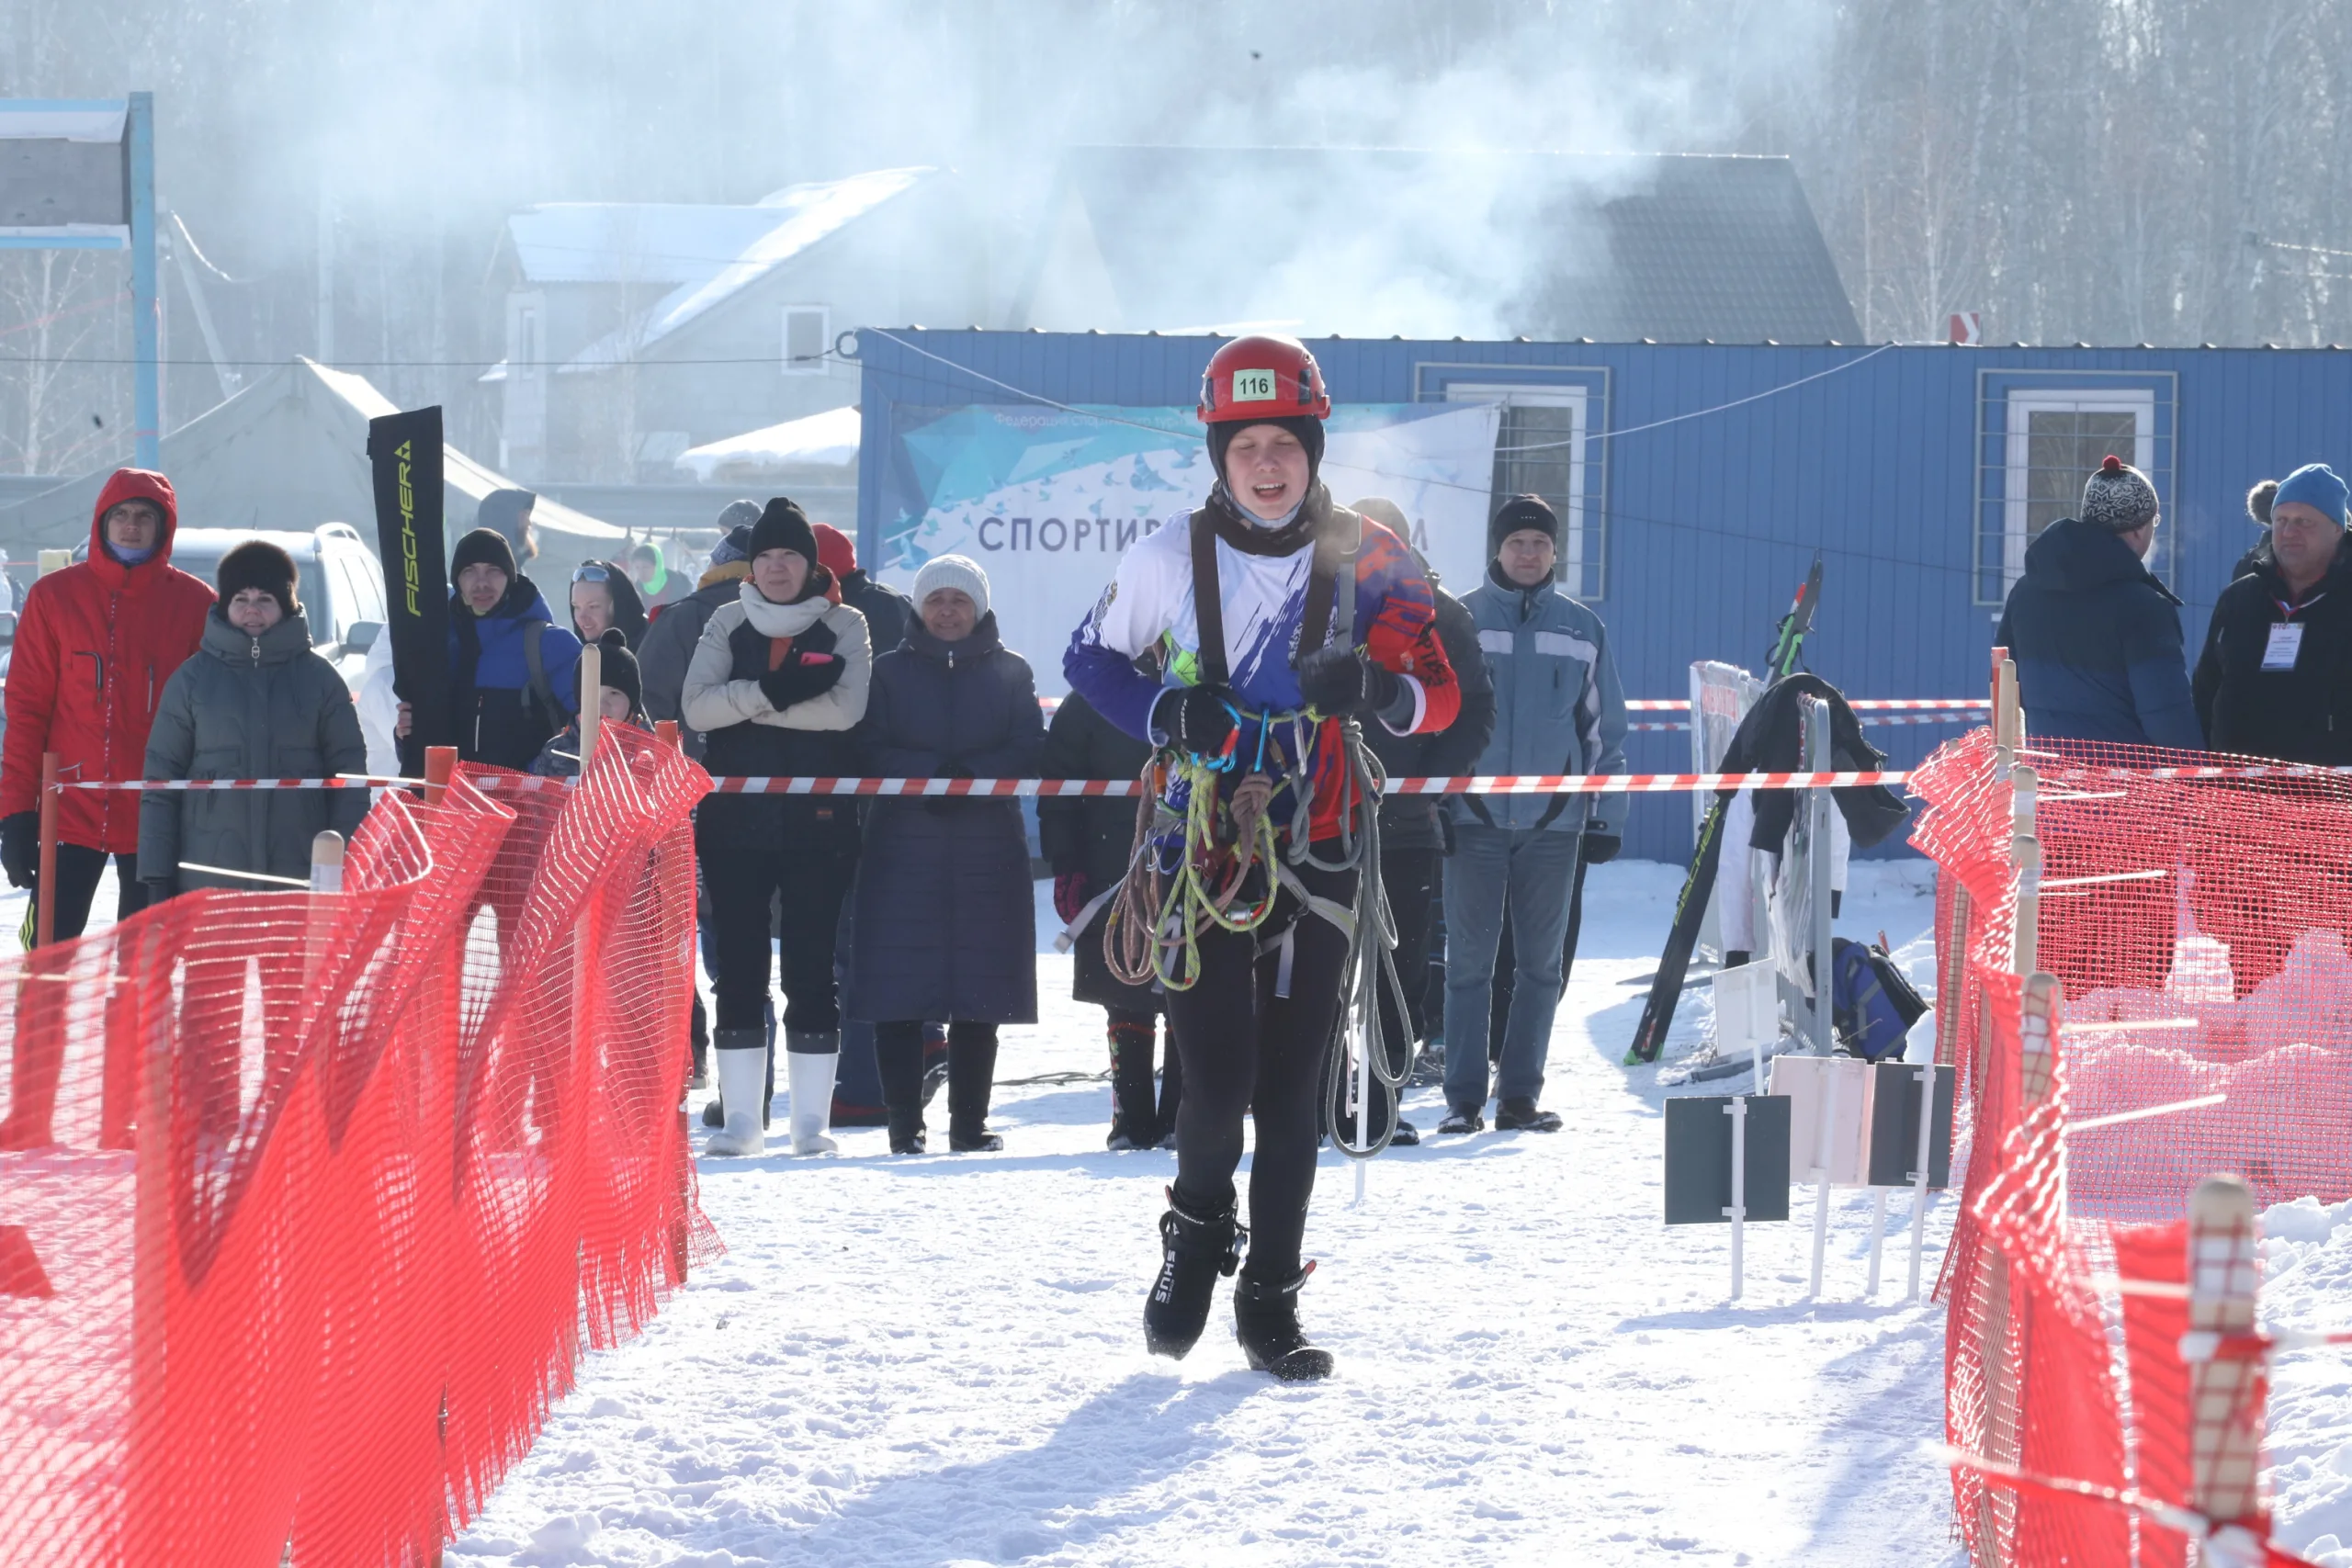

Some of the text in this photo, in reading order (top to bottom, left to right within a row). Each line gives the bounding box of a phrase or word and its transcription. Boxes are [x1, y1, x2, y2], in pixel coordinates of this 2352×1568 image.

[1239, 378, 1269, 395] 116
[399, 461, 422, 617] FISCHER
[1674, 807, 1720, 927] FISCHER
